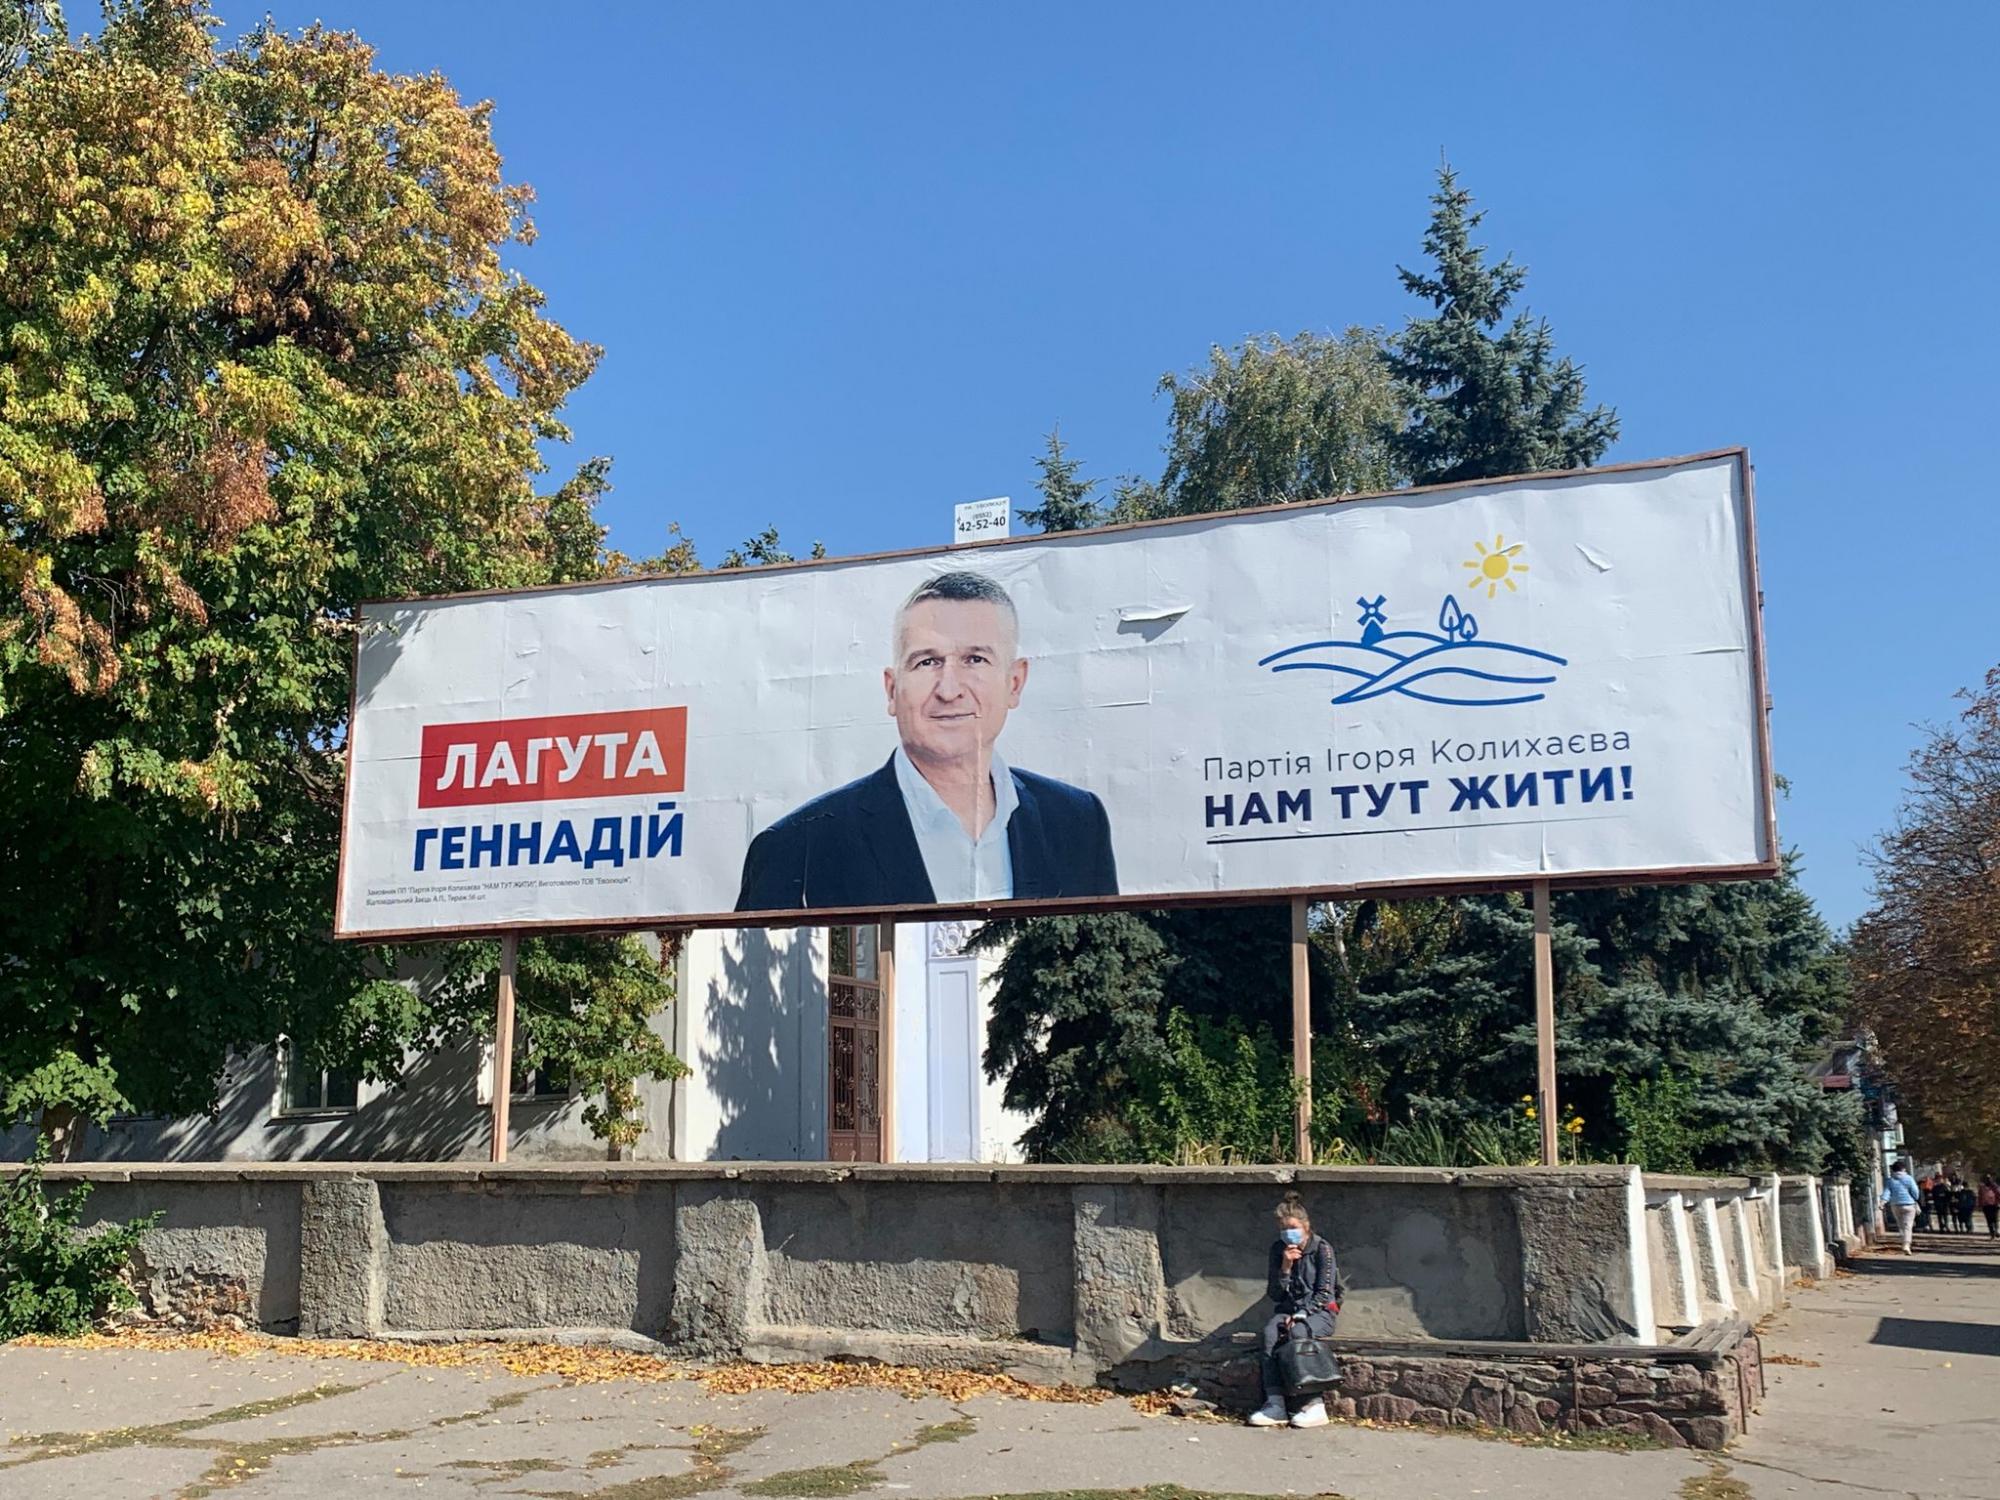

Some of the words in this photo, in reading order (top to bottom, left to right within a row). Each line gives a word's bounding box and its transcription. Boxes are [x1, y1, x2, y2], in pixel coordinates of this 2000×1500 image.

[958, 516, 1006, 532] 42-52-40
[436, 730, 668, 791] ЛАГУТА
[1204, 751, 1311, 782] Партія
[1327, 745, 1415, 773] Ігоря
[1432, 731, 1631, 764] Колихаєва
[1205, 788, 1312, 828] НАМ
[1331, 779, 1429, 819] ТУТ
[1449, 765, 1635, 813] ЖИТИ!
[413, 801, 684, 872] ГЕННАДІЙ
